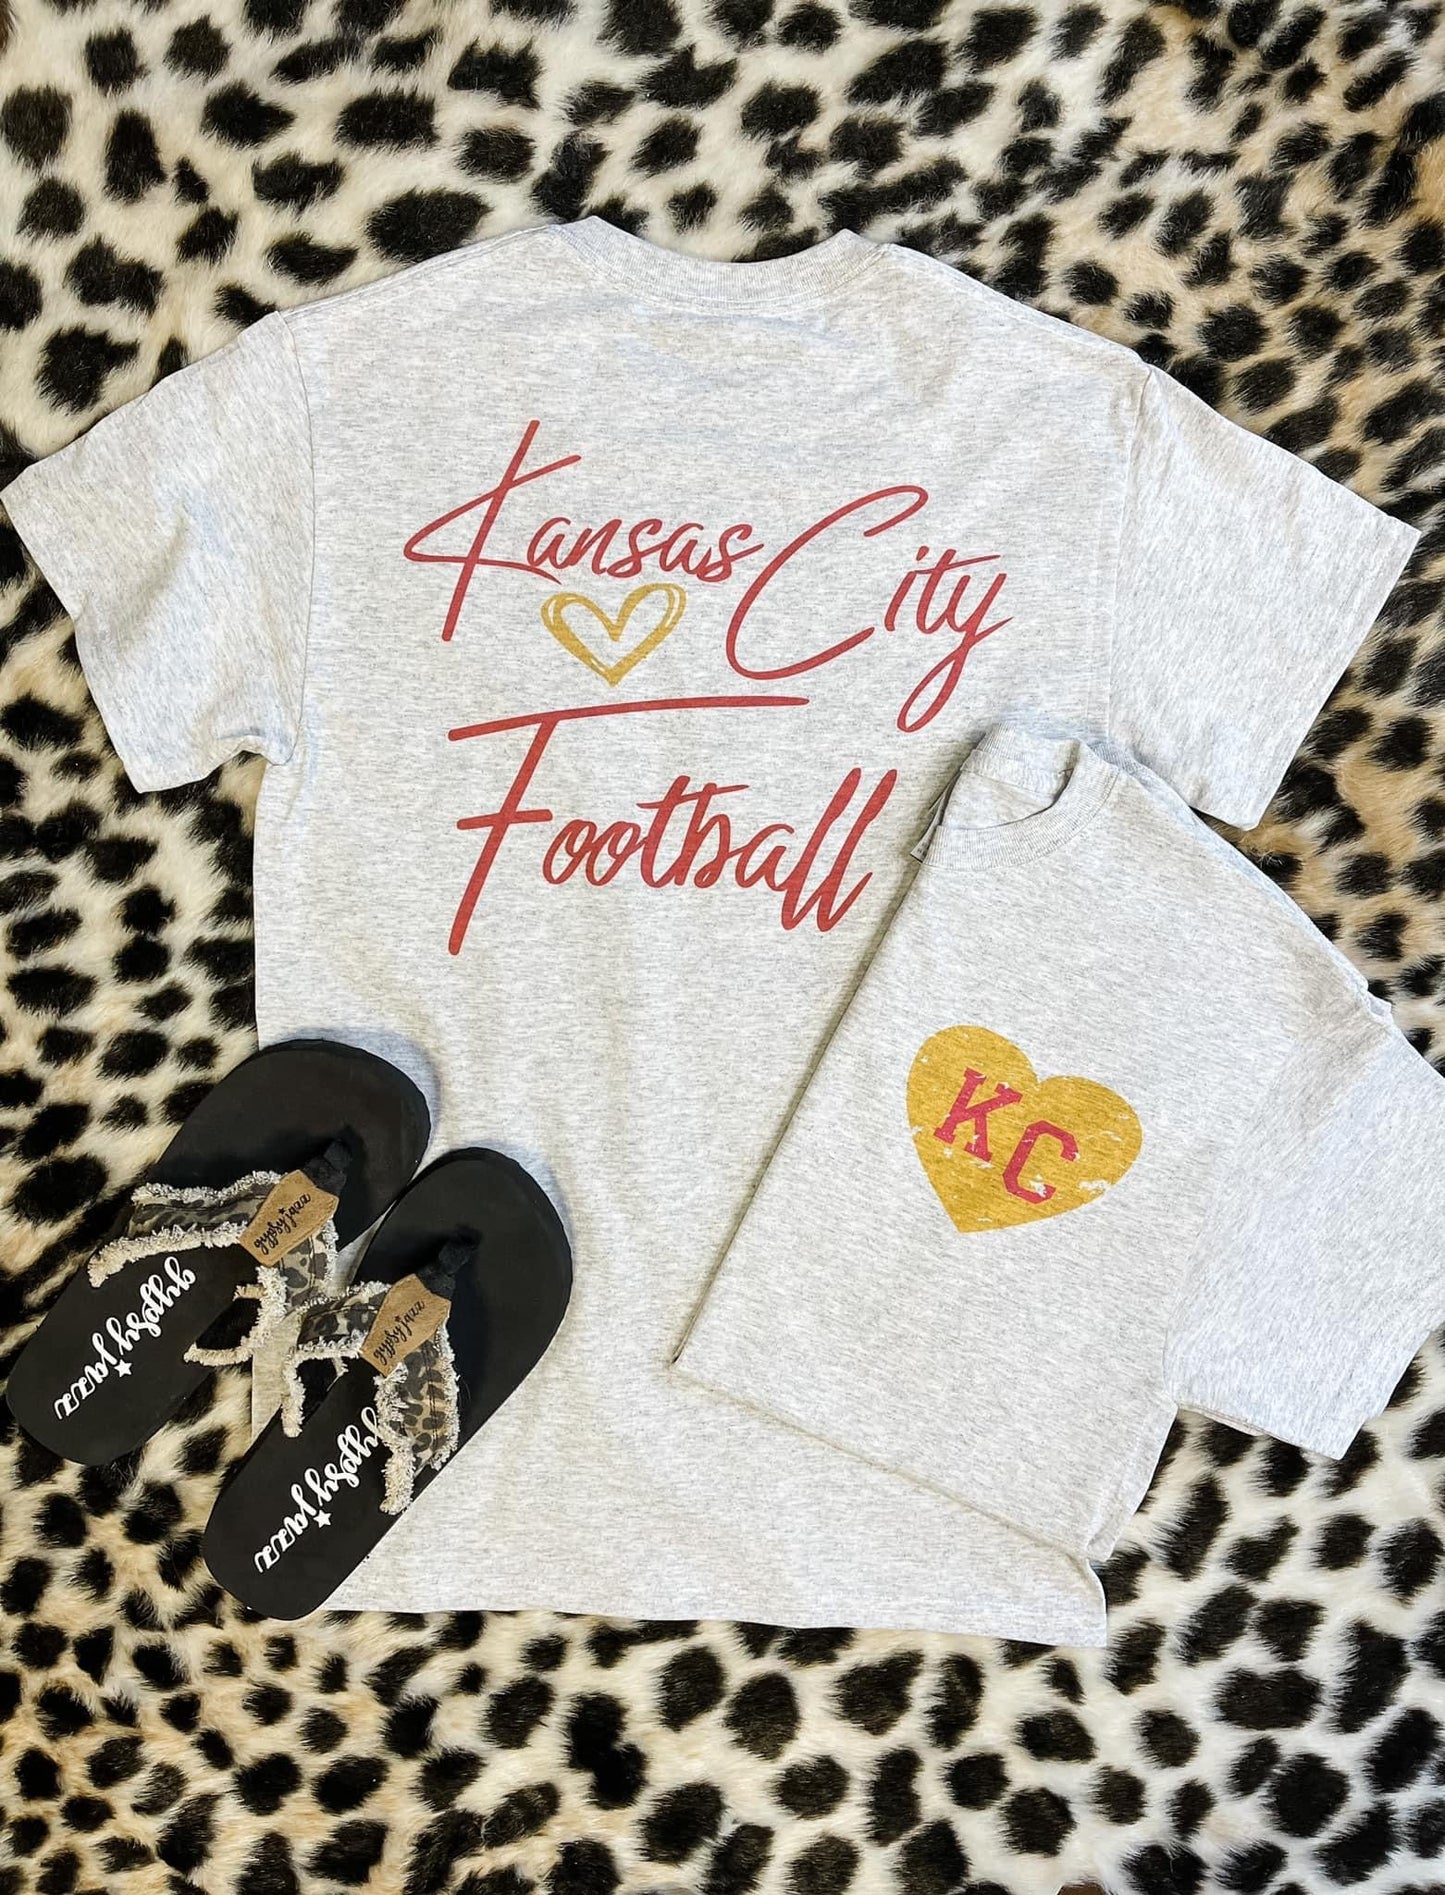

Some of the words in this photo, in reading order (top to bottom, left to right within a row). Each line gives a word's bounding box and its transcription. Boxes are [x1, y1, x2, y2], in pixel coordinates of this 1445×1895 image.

[403, 420, 764, 642] Kansas
[726, 485, 1013, 733] City
[448, 695, 898, 956] Football
[934, 1067, 1079, 1204] KC
[253, 1216, 291, 1255] gypsy
[279, 1194, 311, 1227] jazz
[106, 1256, 196, 1355] gypsy
[373, 1325, 407, 1366] gypsy
[54, 1333, 132, 1420] jazz
[254, 1484, 332, 1573] jazz
